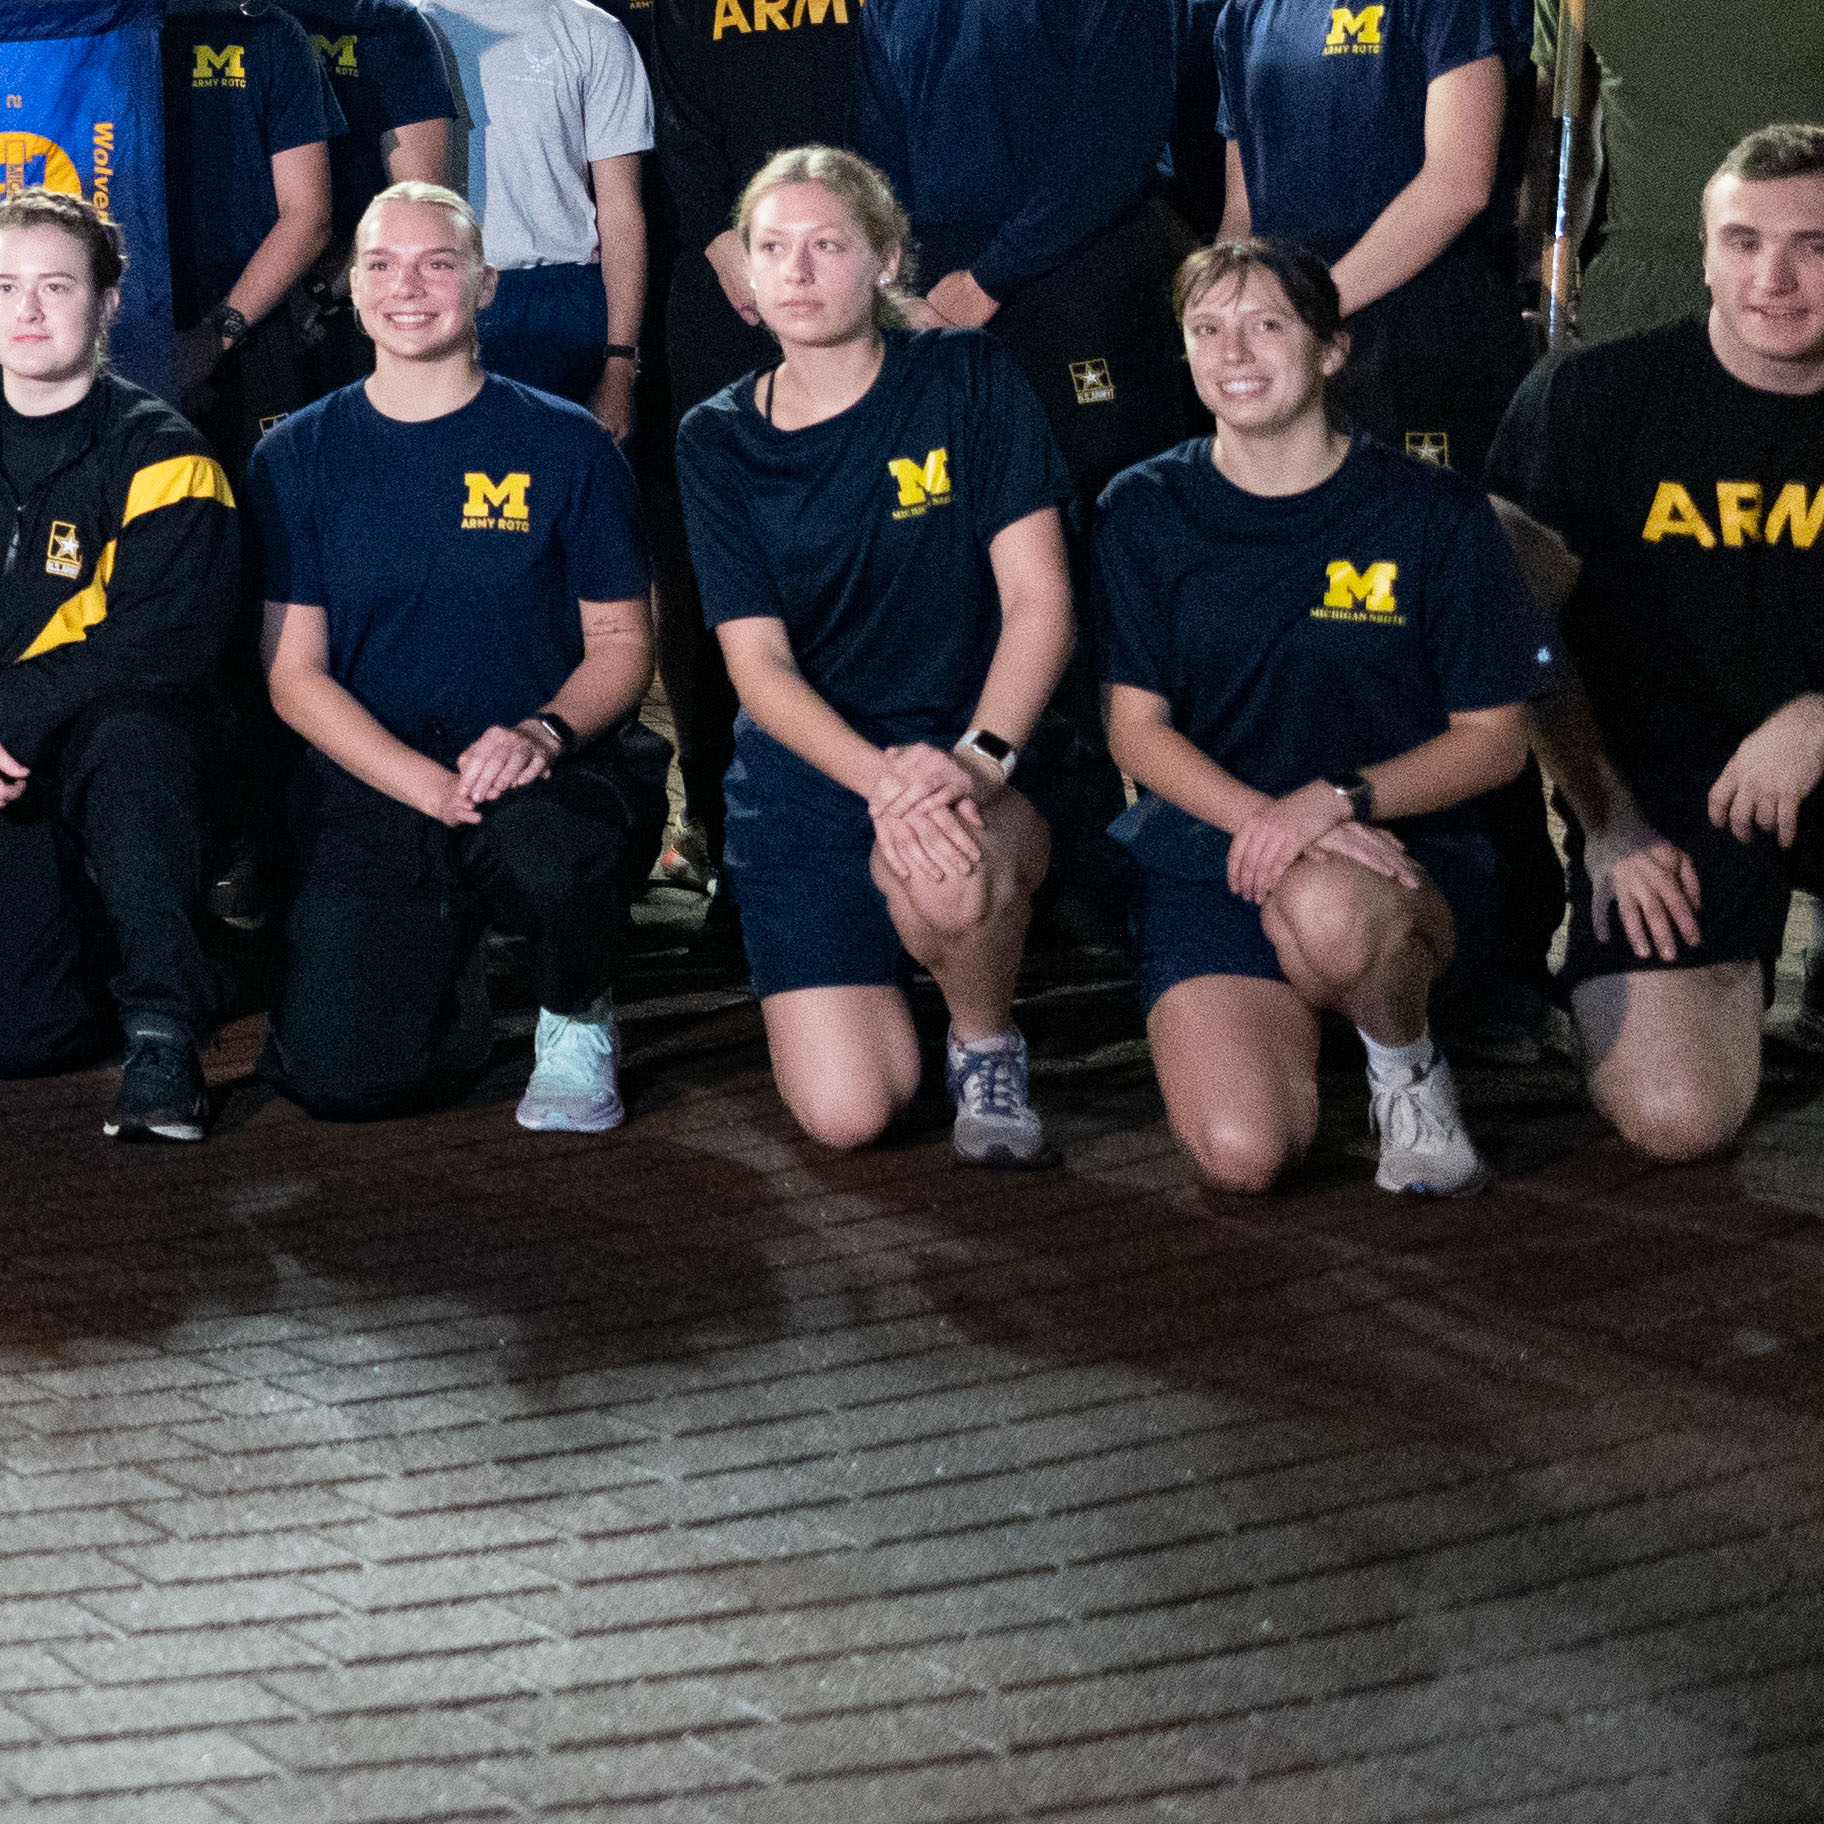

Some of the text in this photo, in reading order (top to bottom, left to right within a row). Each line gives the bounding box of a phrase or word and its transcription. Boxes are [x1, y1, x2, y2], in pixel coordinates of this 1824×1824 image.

[1326, 5, 1385, 45] M
[193, 44, 246, 78] M
[1322, 44, 1381, 56] ARMY ROTC
[192, 79, 247, 89] ARMY ROTC
[887, 446, 952, 507] M
[462, 472, 531, 520] M
[460, 518, 530, 533] ARMY ROTC
[1323, 559, 1398, 612] M
